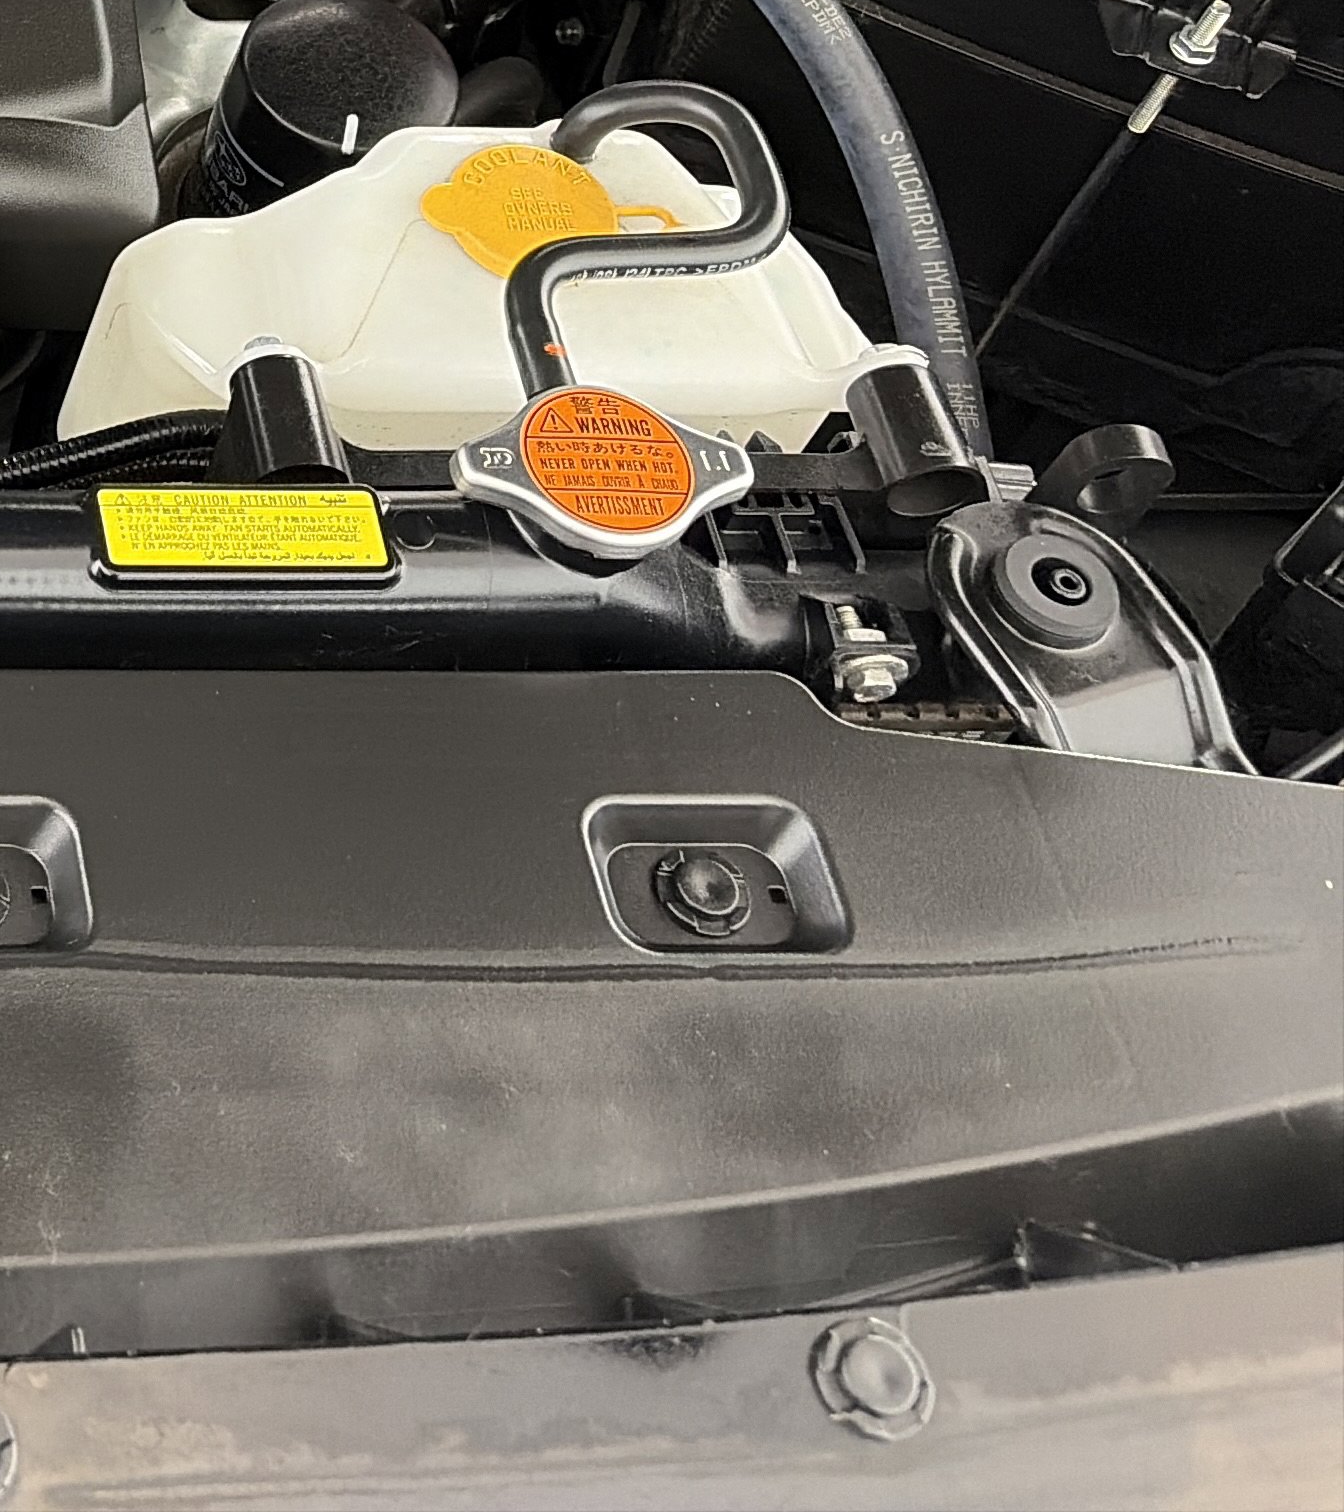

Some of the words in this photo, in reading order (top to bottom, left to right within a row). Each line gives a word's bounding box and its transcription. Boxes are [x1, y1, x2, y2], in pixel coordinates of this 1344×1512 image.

[462, 148, 592, 186] COOLANT
[509, 187, 544, 201] SEE
[507, 216, 577, 232] MANUAL
[920, 260, 968, 358] HYLAMMIT
[568, 396, 621, 415] 警告
[574, 416, 652, 437] WARNING
[539, 458, 576, 470] NEVER
[580, 458, 611, 471] OPEN
[615, 459, 648, 472] WHEN
[544, 474, 556, 486] NE
[173, 494, 229, 506] CAUTION
[239, 494, 307, 506] ATTENTION
[128, 524, 152, 532] KEEP
[155, 524, 190, 532] HANDS
[224, 524, 243, 532] FAN
[245, 524, 280, 532] STARTS
[212, 542, 229, 550] PAS
[232, 542, 249, 550] LES
